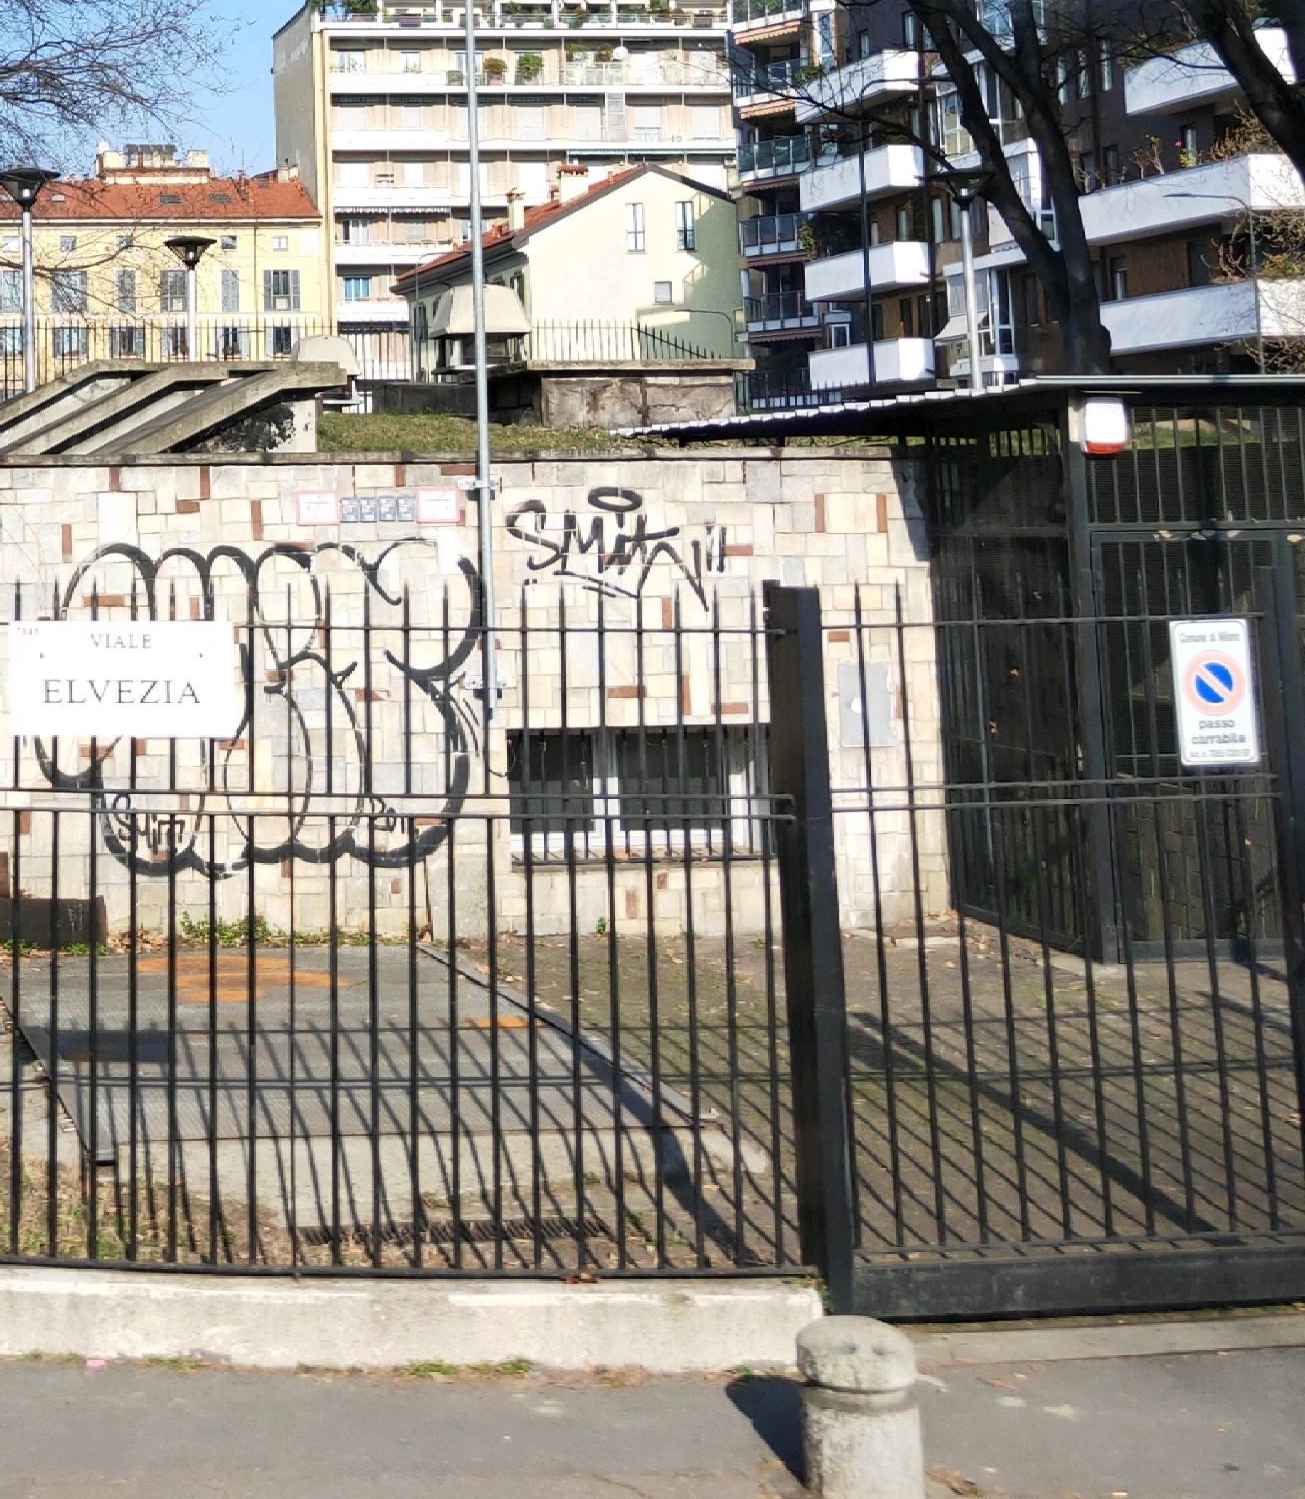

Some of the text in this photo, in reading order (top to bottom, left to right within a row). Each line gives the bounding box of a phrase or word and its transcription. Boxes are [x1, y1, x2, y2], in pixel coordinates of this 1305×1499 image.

[89, 633, 153, 649] VIALE
[41, 678, 202, 704] ELVEZIA
[1199, 719, 1235, 730] passo
[1191, 732, 1246, 745] carrabile
